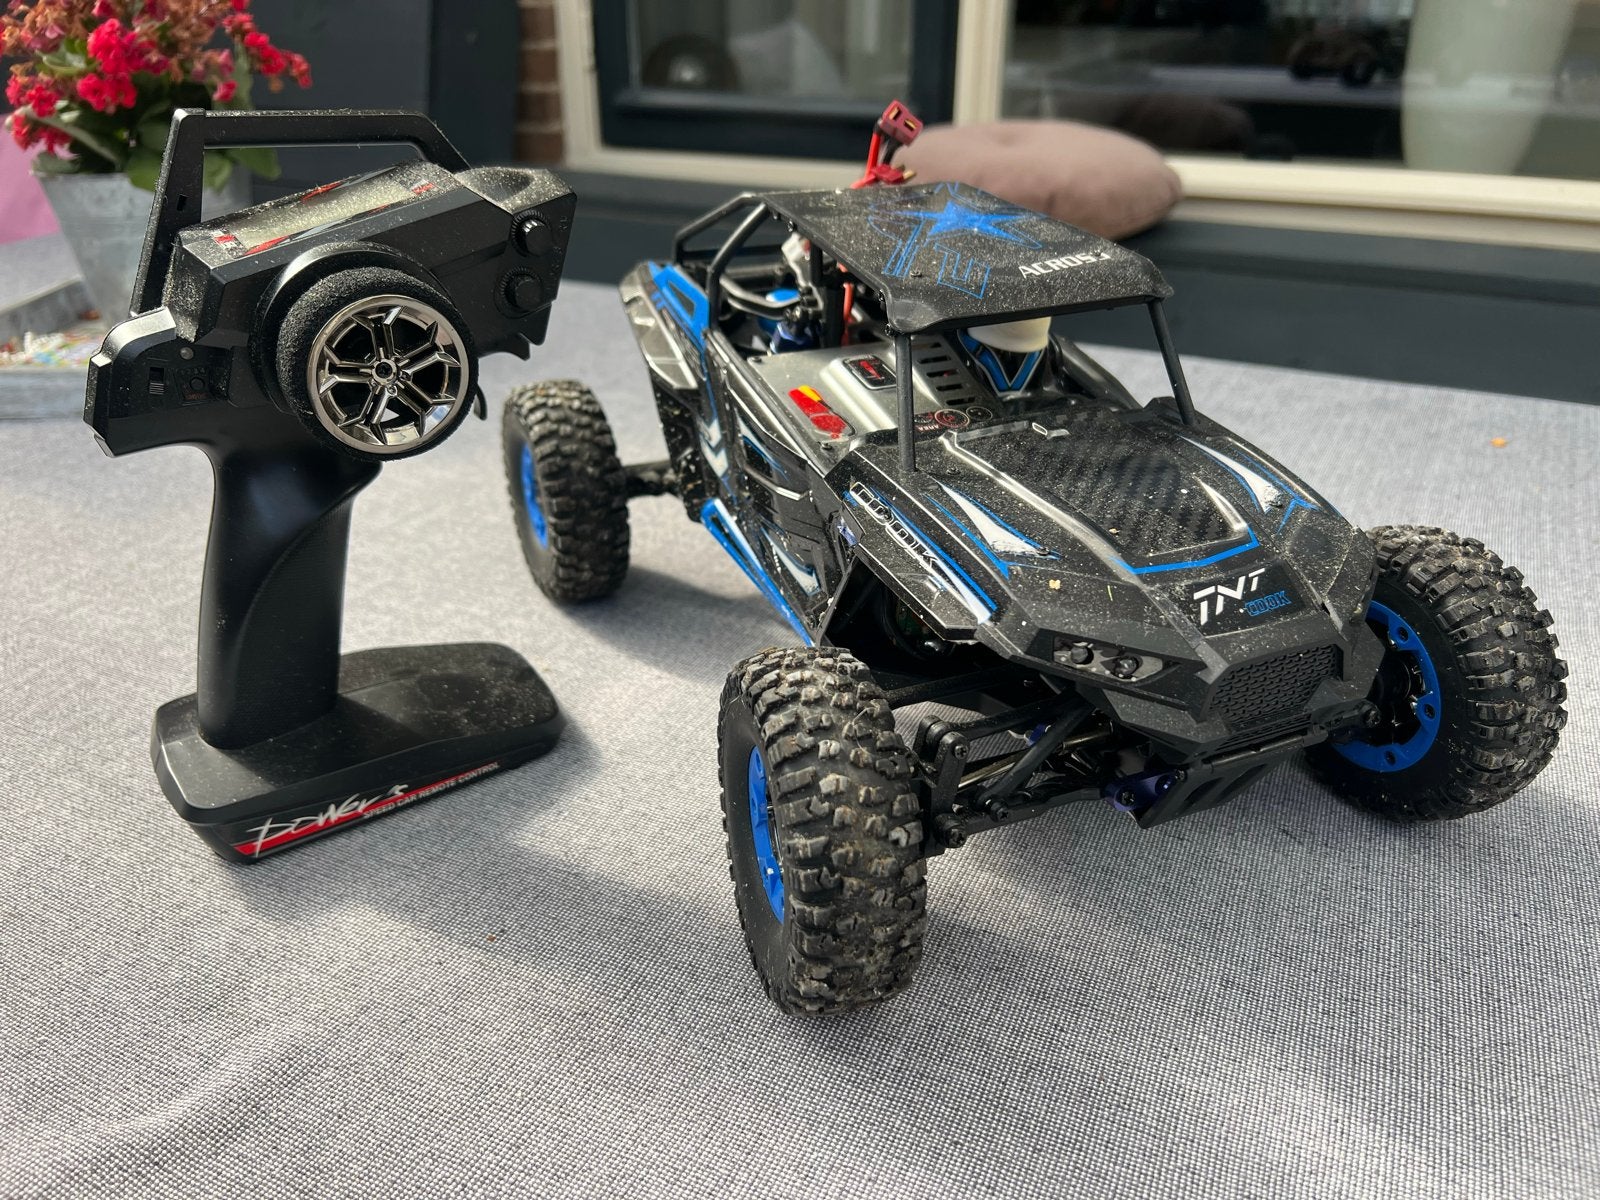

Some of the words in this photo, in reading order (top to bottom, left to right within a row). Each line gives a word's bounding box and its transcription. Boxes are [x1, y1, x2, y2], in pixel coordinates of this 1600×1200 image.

[1193, 567, 1266, 626] TNT
[362, 802, 396, 819] SPEED
[397, 793, 418, 806] CAR
[418, 778, 457, 798] REMOTE
[458, 761, 500, 783] CONTROL
